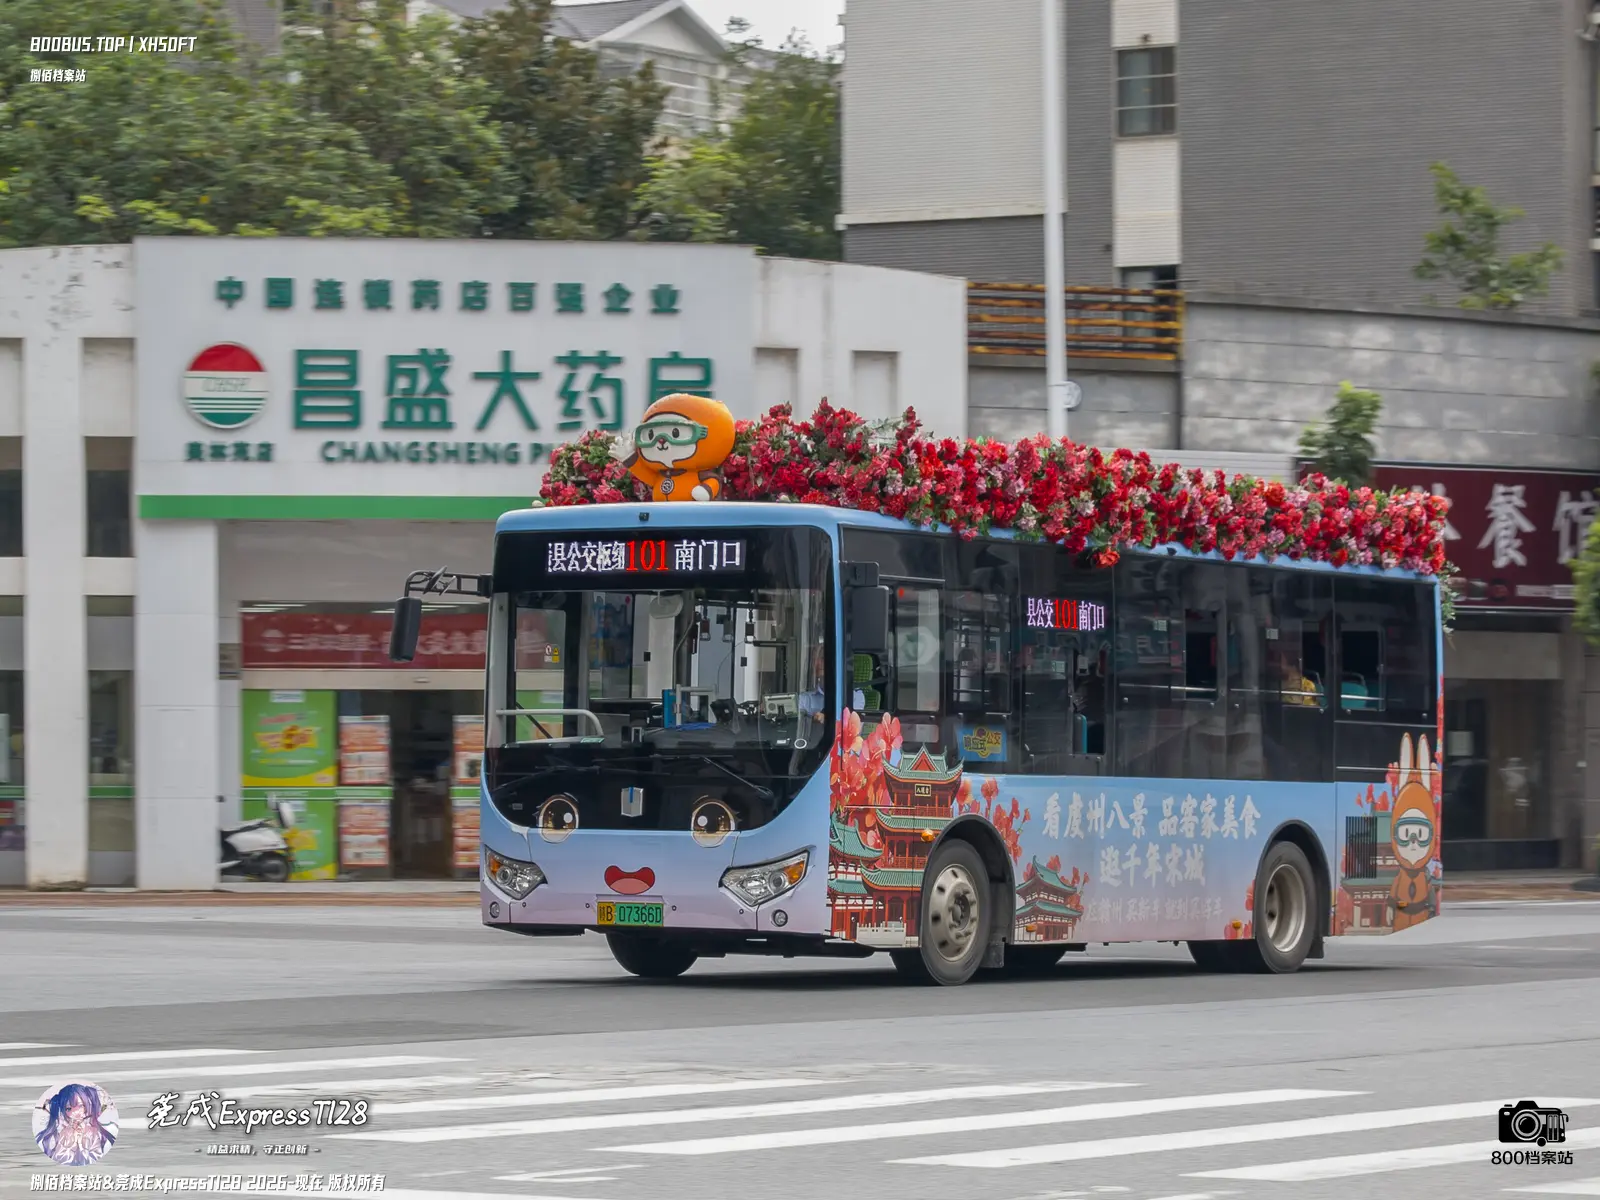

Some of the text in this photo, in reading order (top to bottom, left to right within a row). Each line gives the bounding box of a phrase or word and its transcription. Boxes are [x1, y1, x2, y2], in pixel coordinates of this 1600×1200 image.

[215, 275, 682, 315] 中国连锁药店百强企业
[319, 440, 522, 464] CHANGSHENG
[1411, 483, 1600, 570] 餐馆
[626, 539, 669, 572] 101
[674, 539, 741, 572] 南门口
[1026, 597, 1105, 631] 县公交 101 南门口
[1158, 792, 1261, 841] 品客家美食
[618, 906, 662, 923] 07366D
